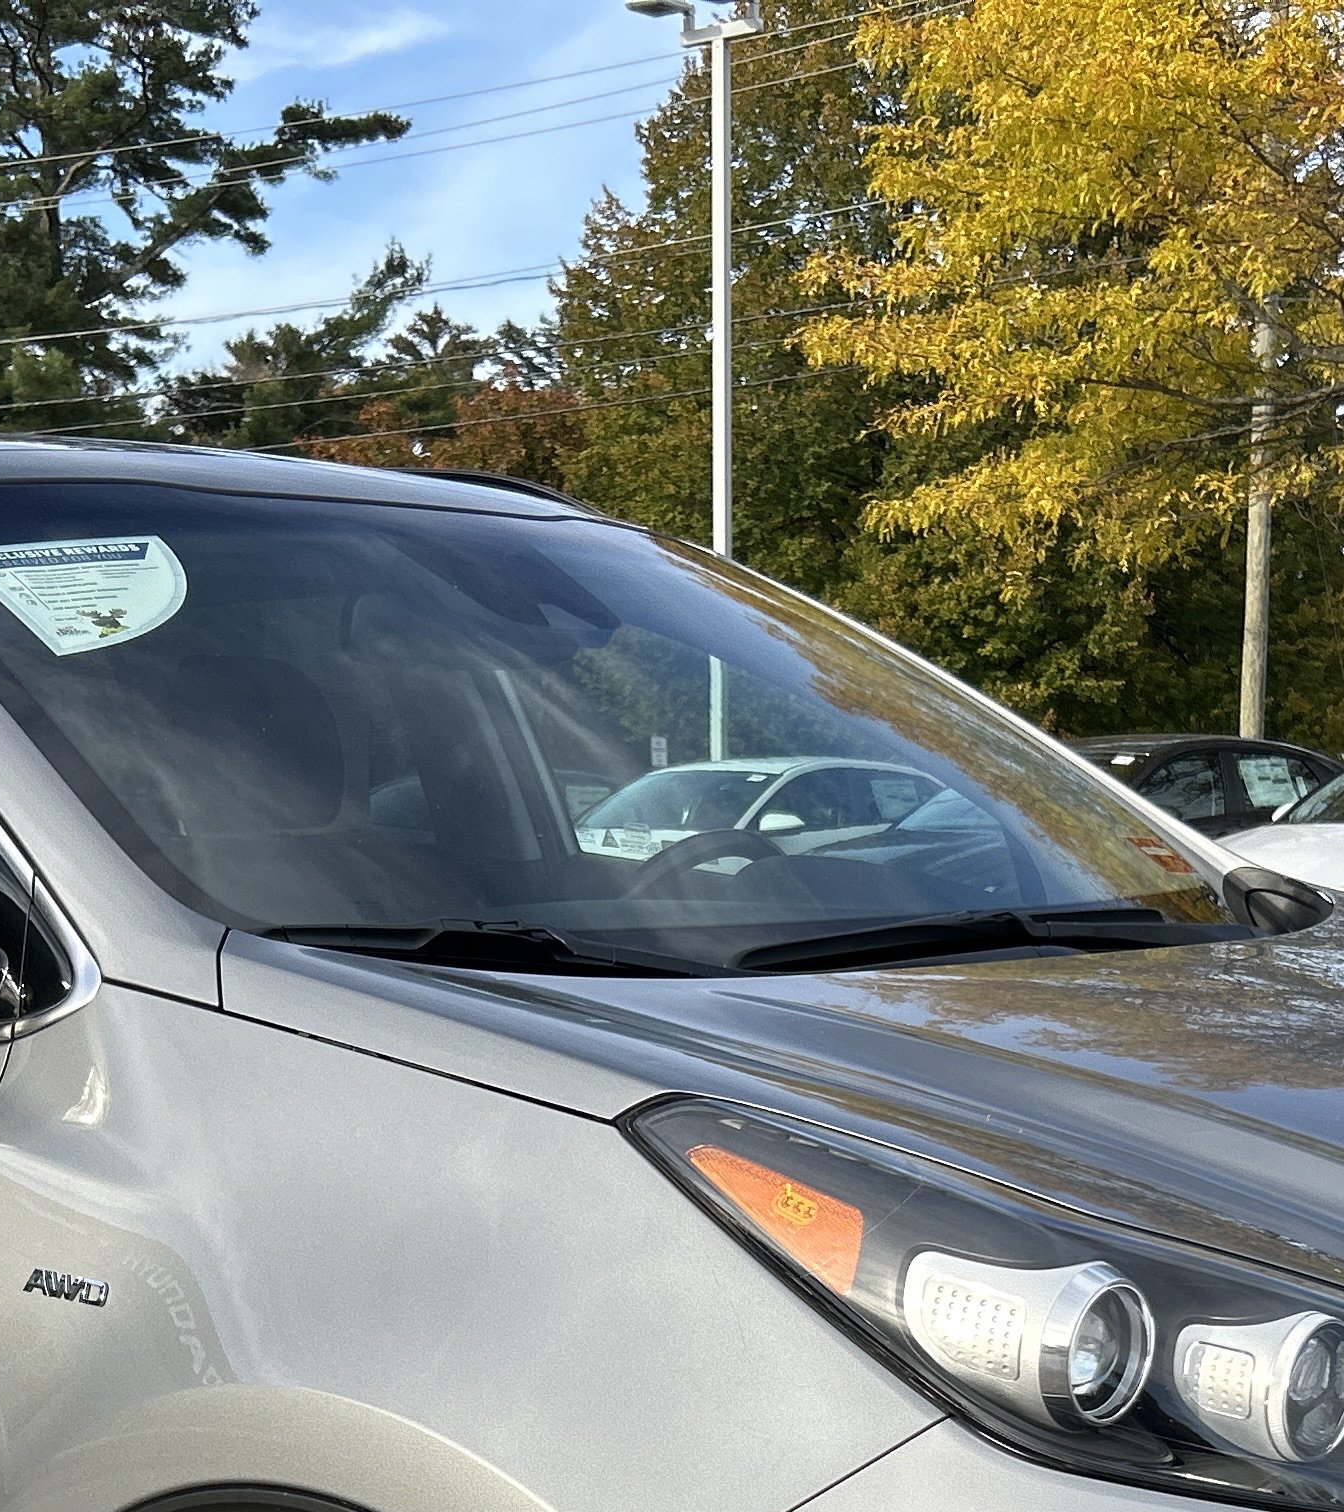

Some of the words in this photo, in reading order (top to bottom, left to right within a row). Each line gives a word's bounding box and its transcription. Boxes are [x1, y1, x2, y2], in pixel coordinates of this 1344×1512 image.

[62, 544, 140, 556] REWARDS
[62, 553, 91, 564] FOR
[23, 1268, 109, 1307] AWD
